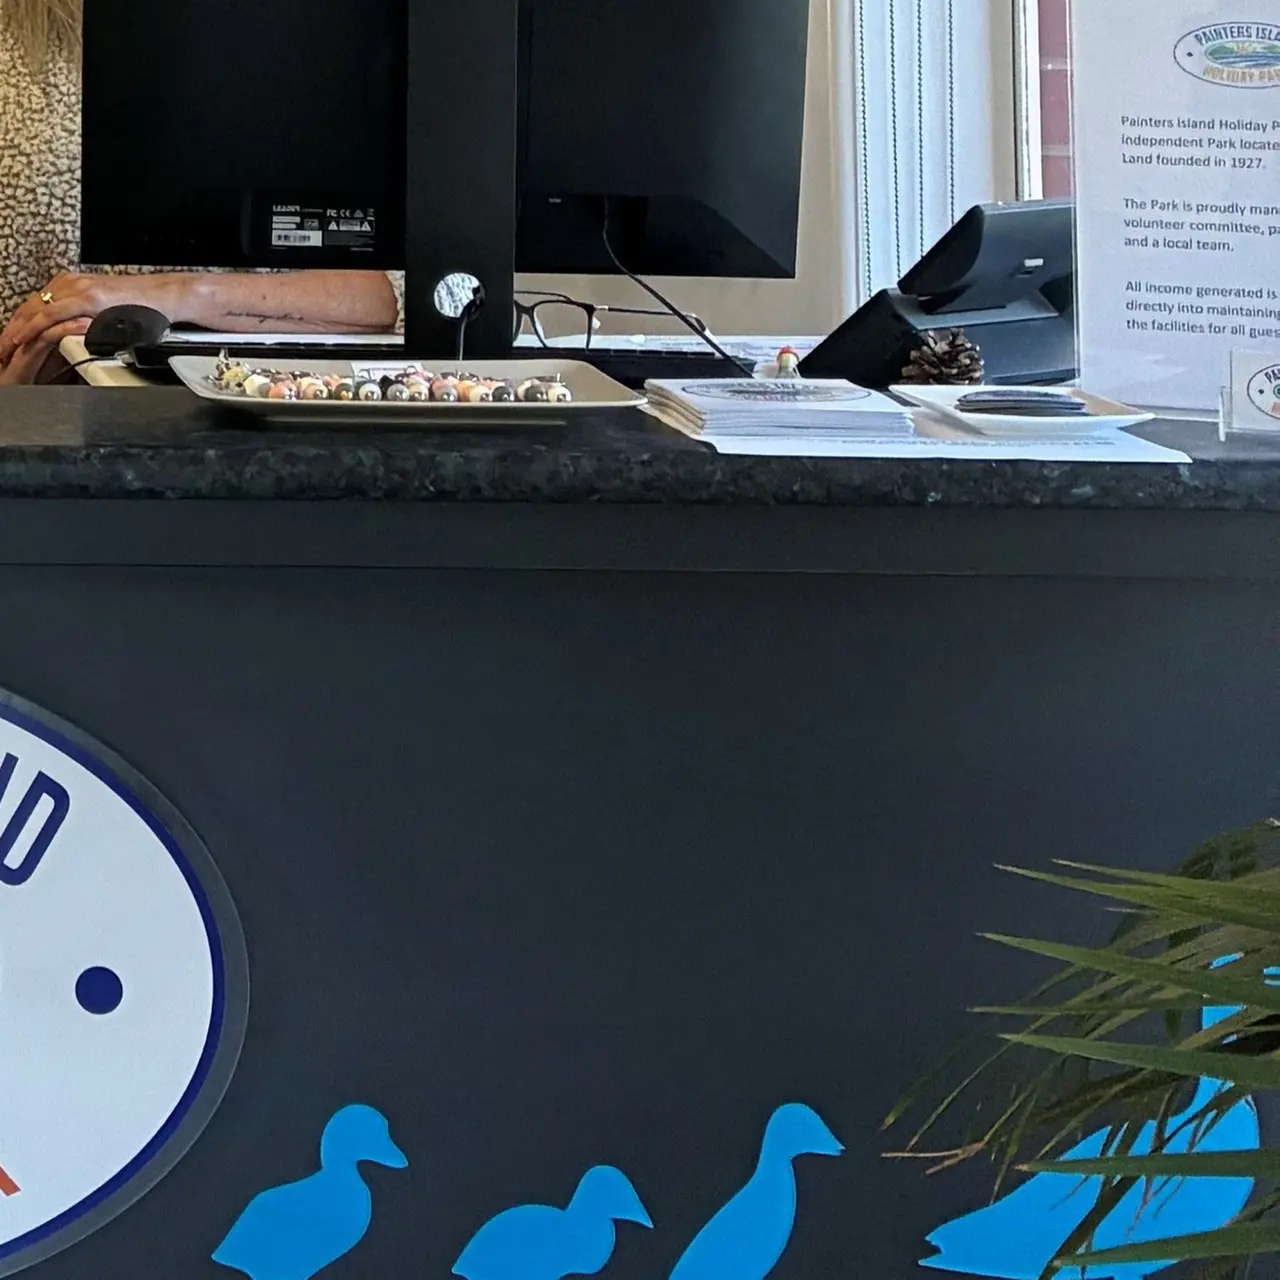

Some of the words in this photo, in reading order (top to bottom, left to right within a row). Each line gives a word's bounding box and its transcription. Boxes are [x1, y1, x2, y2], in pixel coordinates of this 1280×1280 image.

[1194, 25, 1252, 46] PAINTERS
[1121, 116, 1174, 128] Painters
[1177, 116, 1215, 130] Island
[1219, 118, 1268, 134] Holiday
[1121, 133, 1204, 148] Independent
[1207, 137, 1236, 150] Park
[1122, 152, 1153, 165] Land
[1156, 153, 1210, 167] founded
[1214, 156, 1226, 167] in
[1231, 157, 1267, 169] 1927.
[1123, 198, 1147, 210] The
[1151, 199, 1179, 211] Park
[1182, 200, 1193, 212] is
[1196, 201, 1247, 216] proudly
[1250, 206, 1280, 216] man
[1123, 218, 1185, 230] volunteer
[1189, 221, 1265, 236] committee,
[1124, 235, 1148, 248] and
[1152, 238, 1159, 248] a
[1163, 236, 1193, 250] local
[1196, 239, 1234, 252] team.
[1125, 280, 1141, 293] All
[1145, 281, 1193, 296] income
[1196, 286, 1263, 300] generated
[1266, 288, 1278, 300] is
[1125, 298, 1175, 315] directly
[1177, 302, 1204, 314] into
[1126, 318, 1149, 331] the
[1151, 319, 1206, 334] facilities
[1208, 322, 1227, 334] for
[1230, 324, 1245, 336] all
